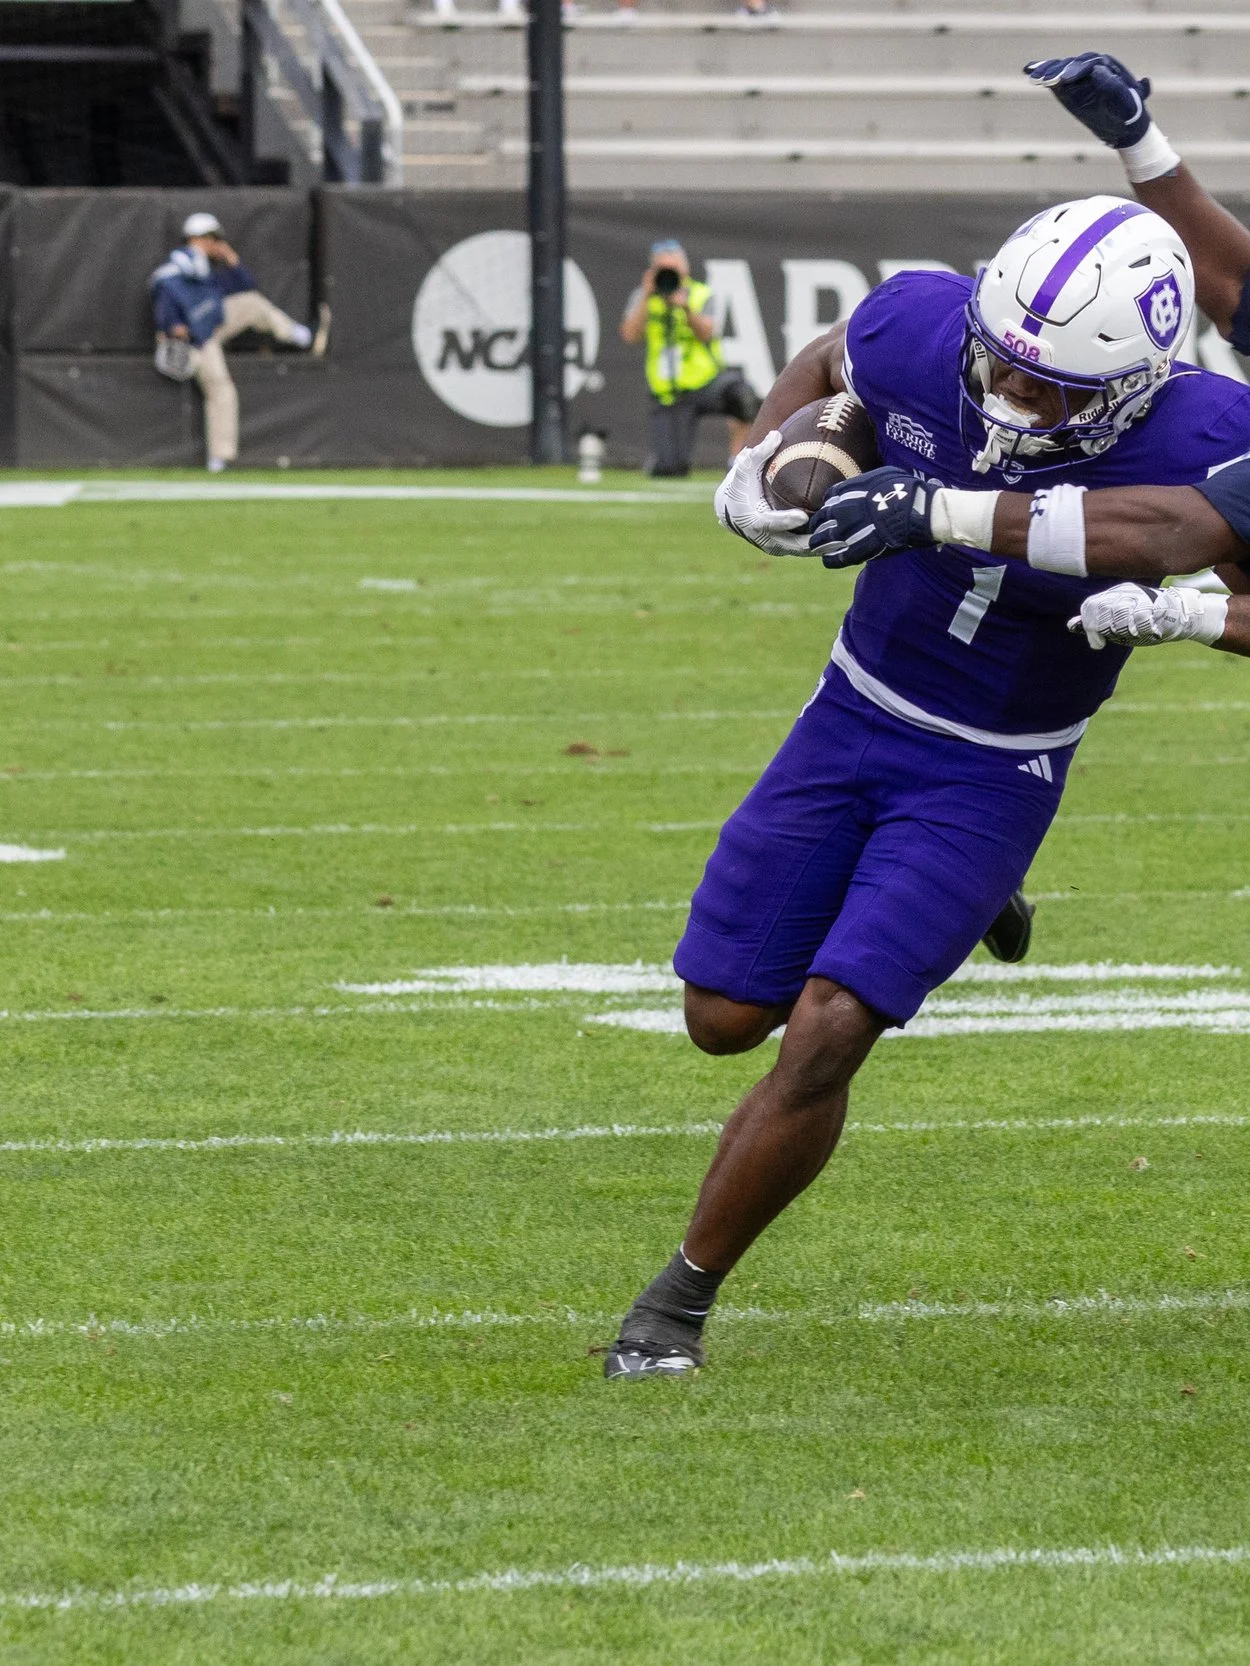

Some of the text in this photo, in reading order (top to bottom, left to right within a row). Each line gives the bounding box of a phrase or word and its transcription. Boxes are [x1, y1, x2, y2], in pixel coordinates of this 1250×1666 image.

[436, 327, 593, 373] NCA
[1002, 329, 1042, 363] 508
[885, 421, 938, 452] PATRIOT
[885, 428, 937, 461] LEAGUE
